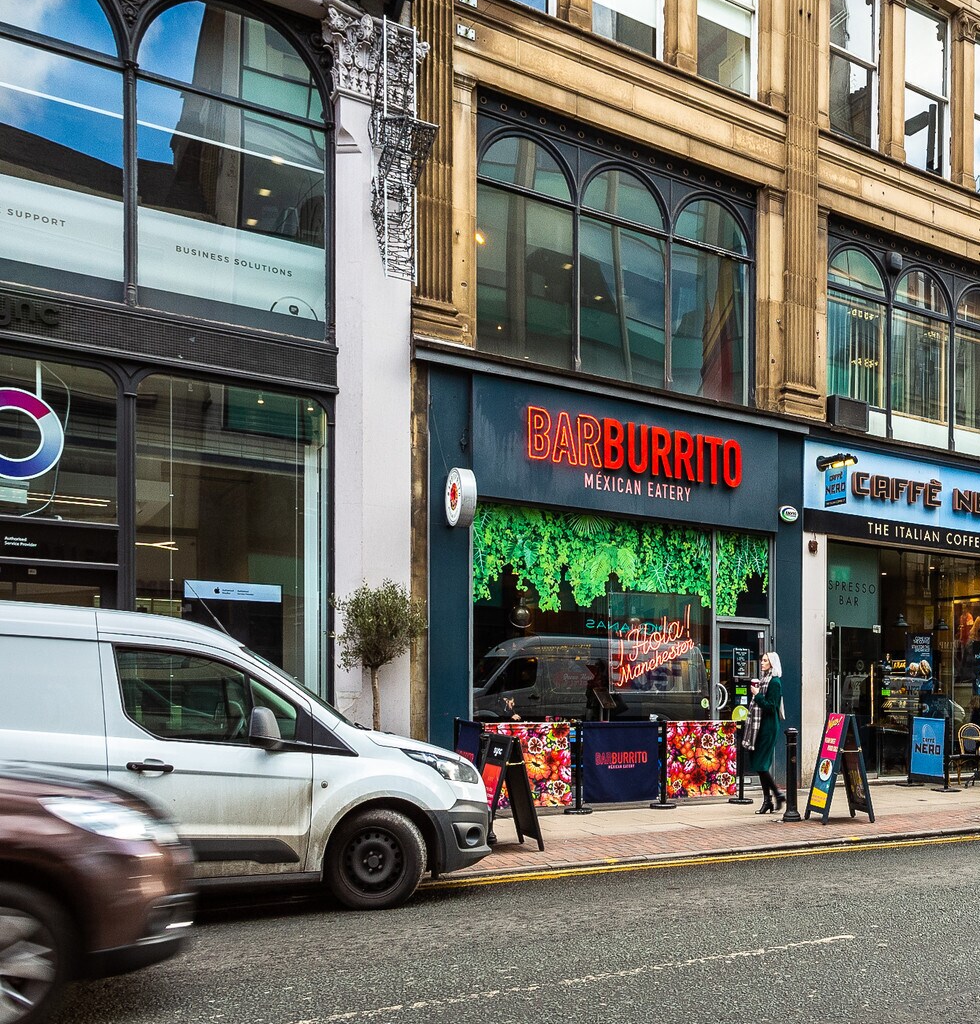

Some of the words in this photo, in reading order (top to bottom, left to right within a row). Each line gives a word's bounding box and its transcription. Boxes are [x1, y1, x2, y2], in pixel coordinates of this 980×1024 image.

[7, 208, 66, 227] SUPPORT
[175, 245, 230, 264] BUSINESS
[233, 258, 293, 278] SOLUTIONS
[528, 406, 742, 488] BARBURRITO
[646, 482, 691, 503] EATERY
[825, 482, 846, 494] NERO
[851, 472, 942, 508] CAFFÈ
[867, 521, 889, 541] THE
[895, 526, 940, 547] ITALIAN
[839, 595, 859, 607] BAR
[617, 637, 696, 687] Manchester
[595, 751, 648, 765] BARBURRITO
[915, 746, 941, 760] NERO
